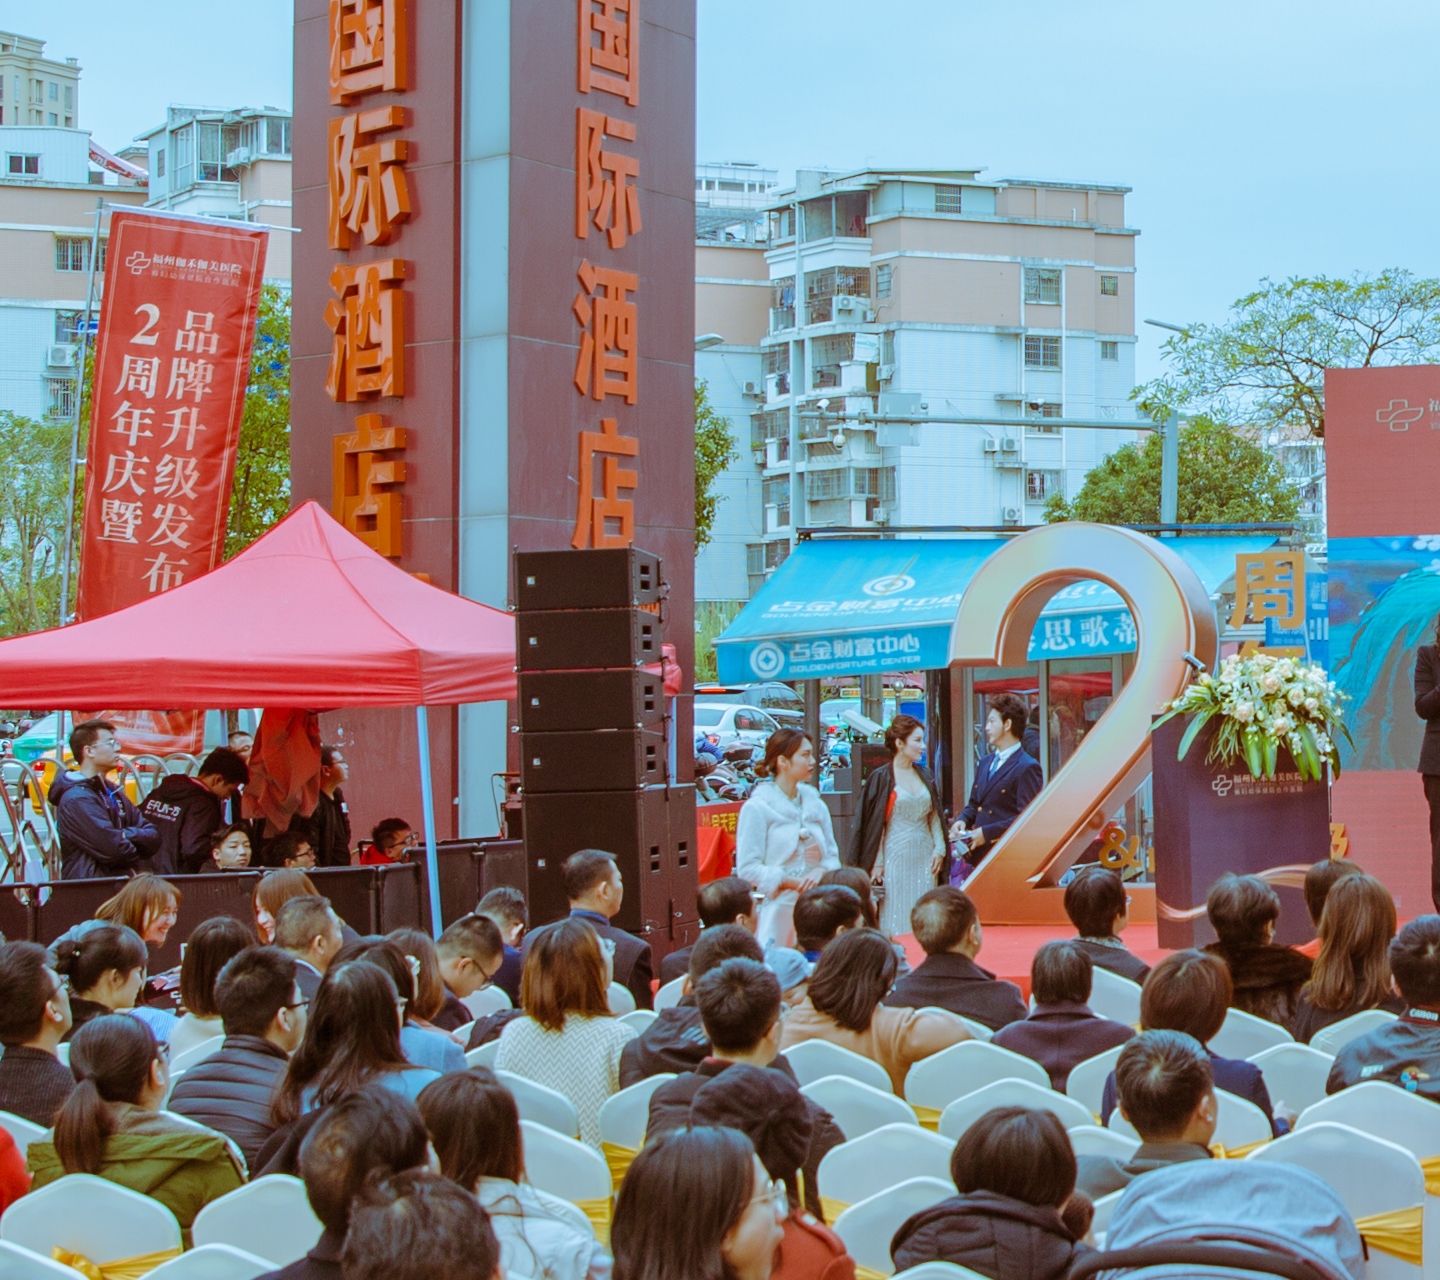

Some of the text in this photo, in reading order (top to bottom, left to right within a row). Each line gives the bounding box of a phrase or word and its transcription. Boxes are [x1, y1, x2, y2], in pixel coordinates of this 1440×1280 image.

[96, 303, 160, 543] 2周年庆暨
[143, 310, 220, 594] 品牌升级发布
[1027, 612, 1138, 652] 思歌蒂
[1229, 551, 1305, 662] 周
[881, 655, 921, 665] CENTER
[1099, 828, 1142, 869] &
